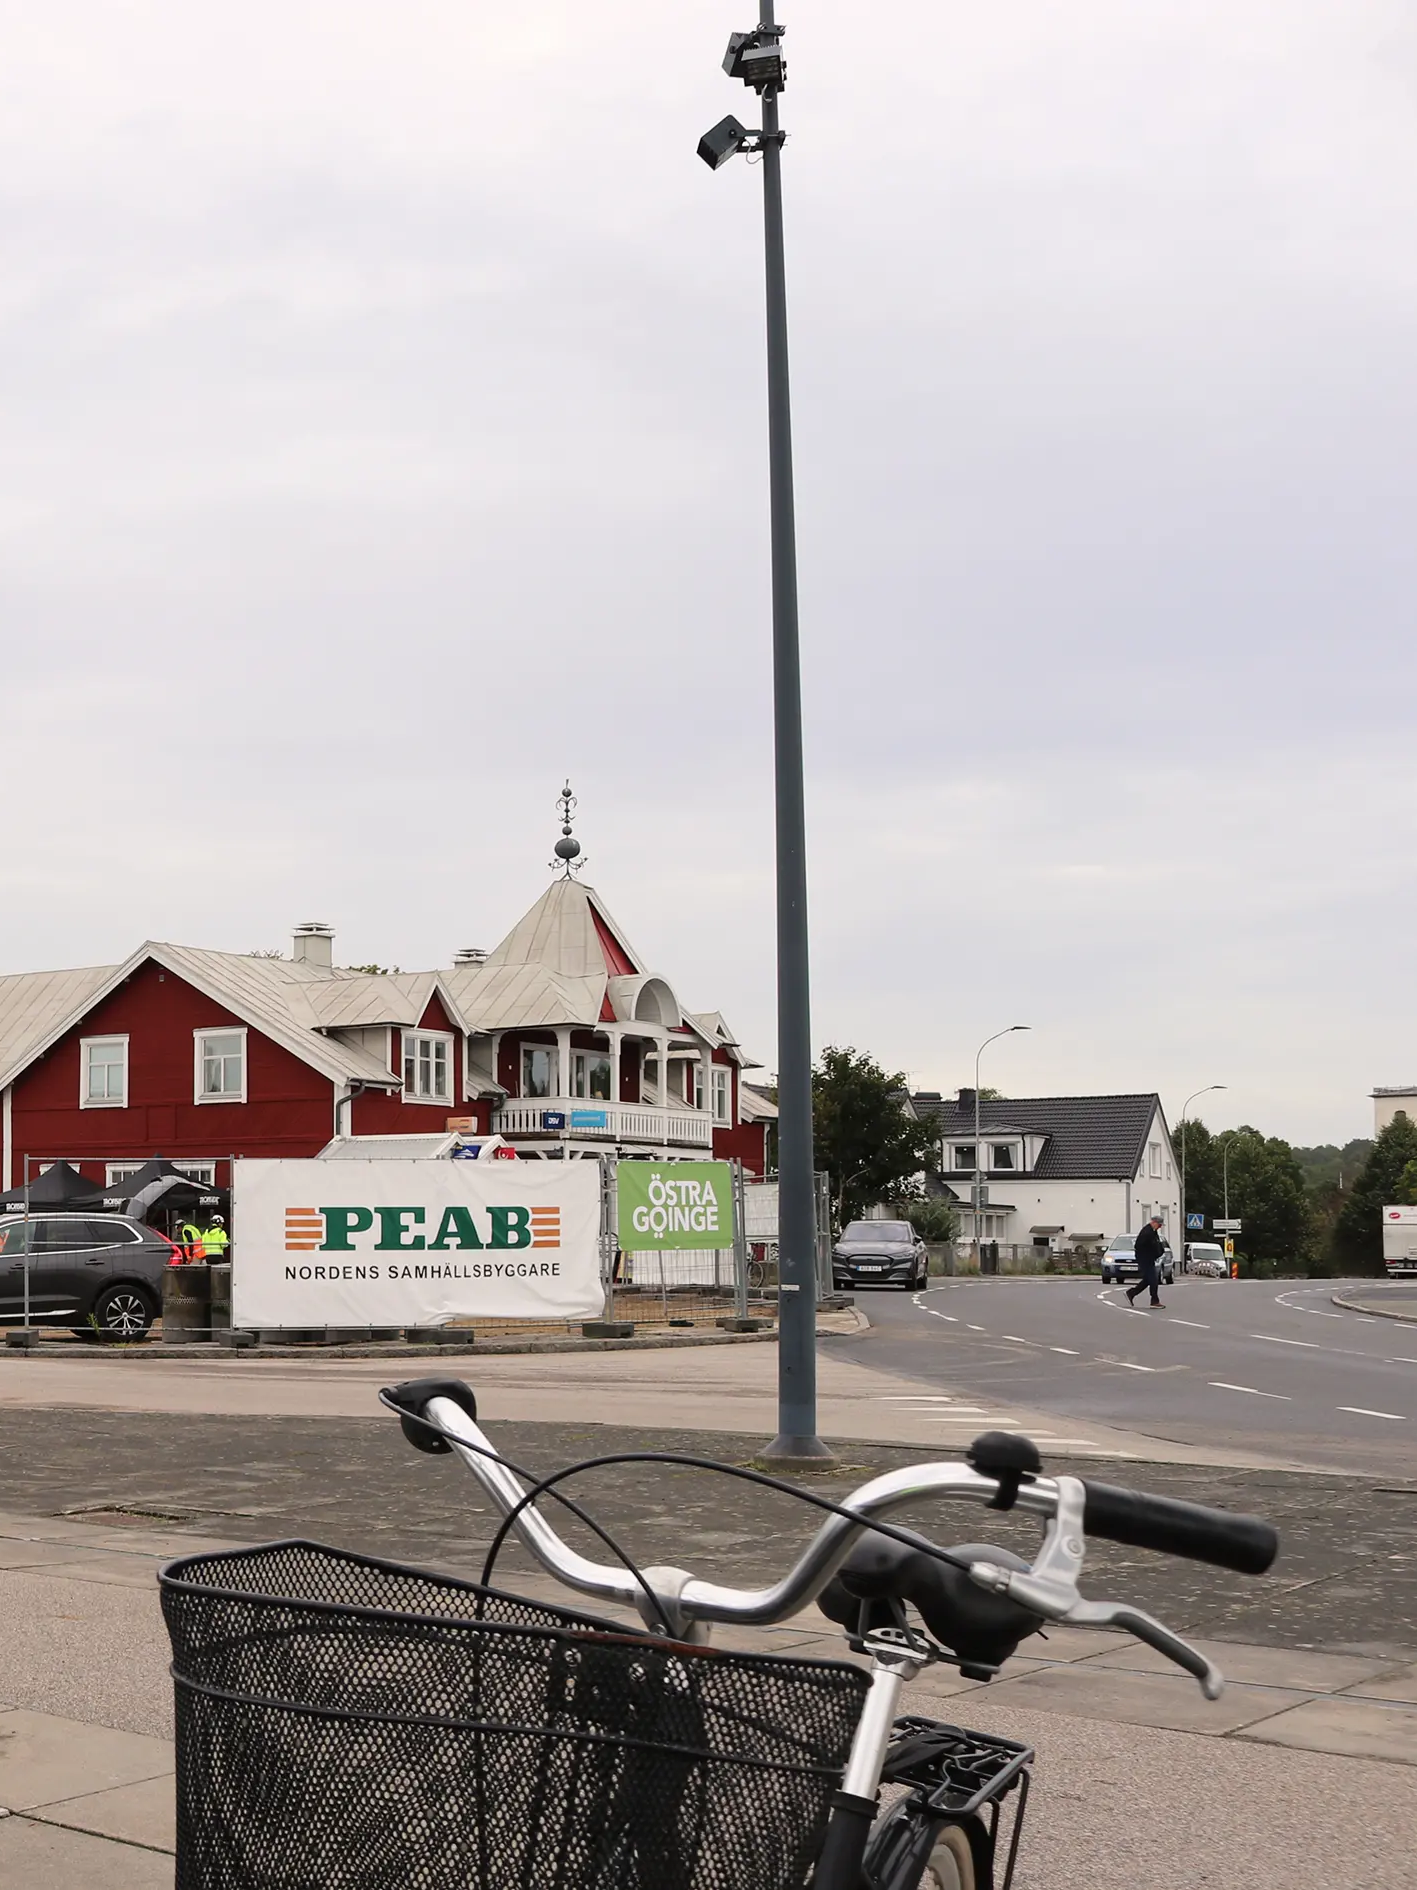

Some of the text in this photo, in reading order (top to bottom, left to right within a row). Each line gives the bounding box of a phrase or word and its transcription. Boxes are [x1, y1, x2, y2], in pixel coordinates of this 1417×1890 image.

[648, 1173, 717, 1206] ÖSTRA
[319, 1206, 532, 1251] PEAB
[285, 1261, 560, 1280] NORDENS SAMHÄLLSBYGGARE
